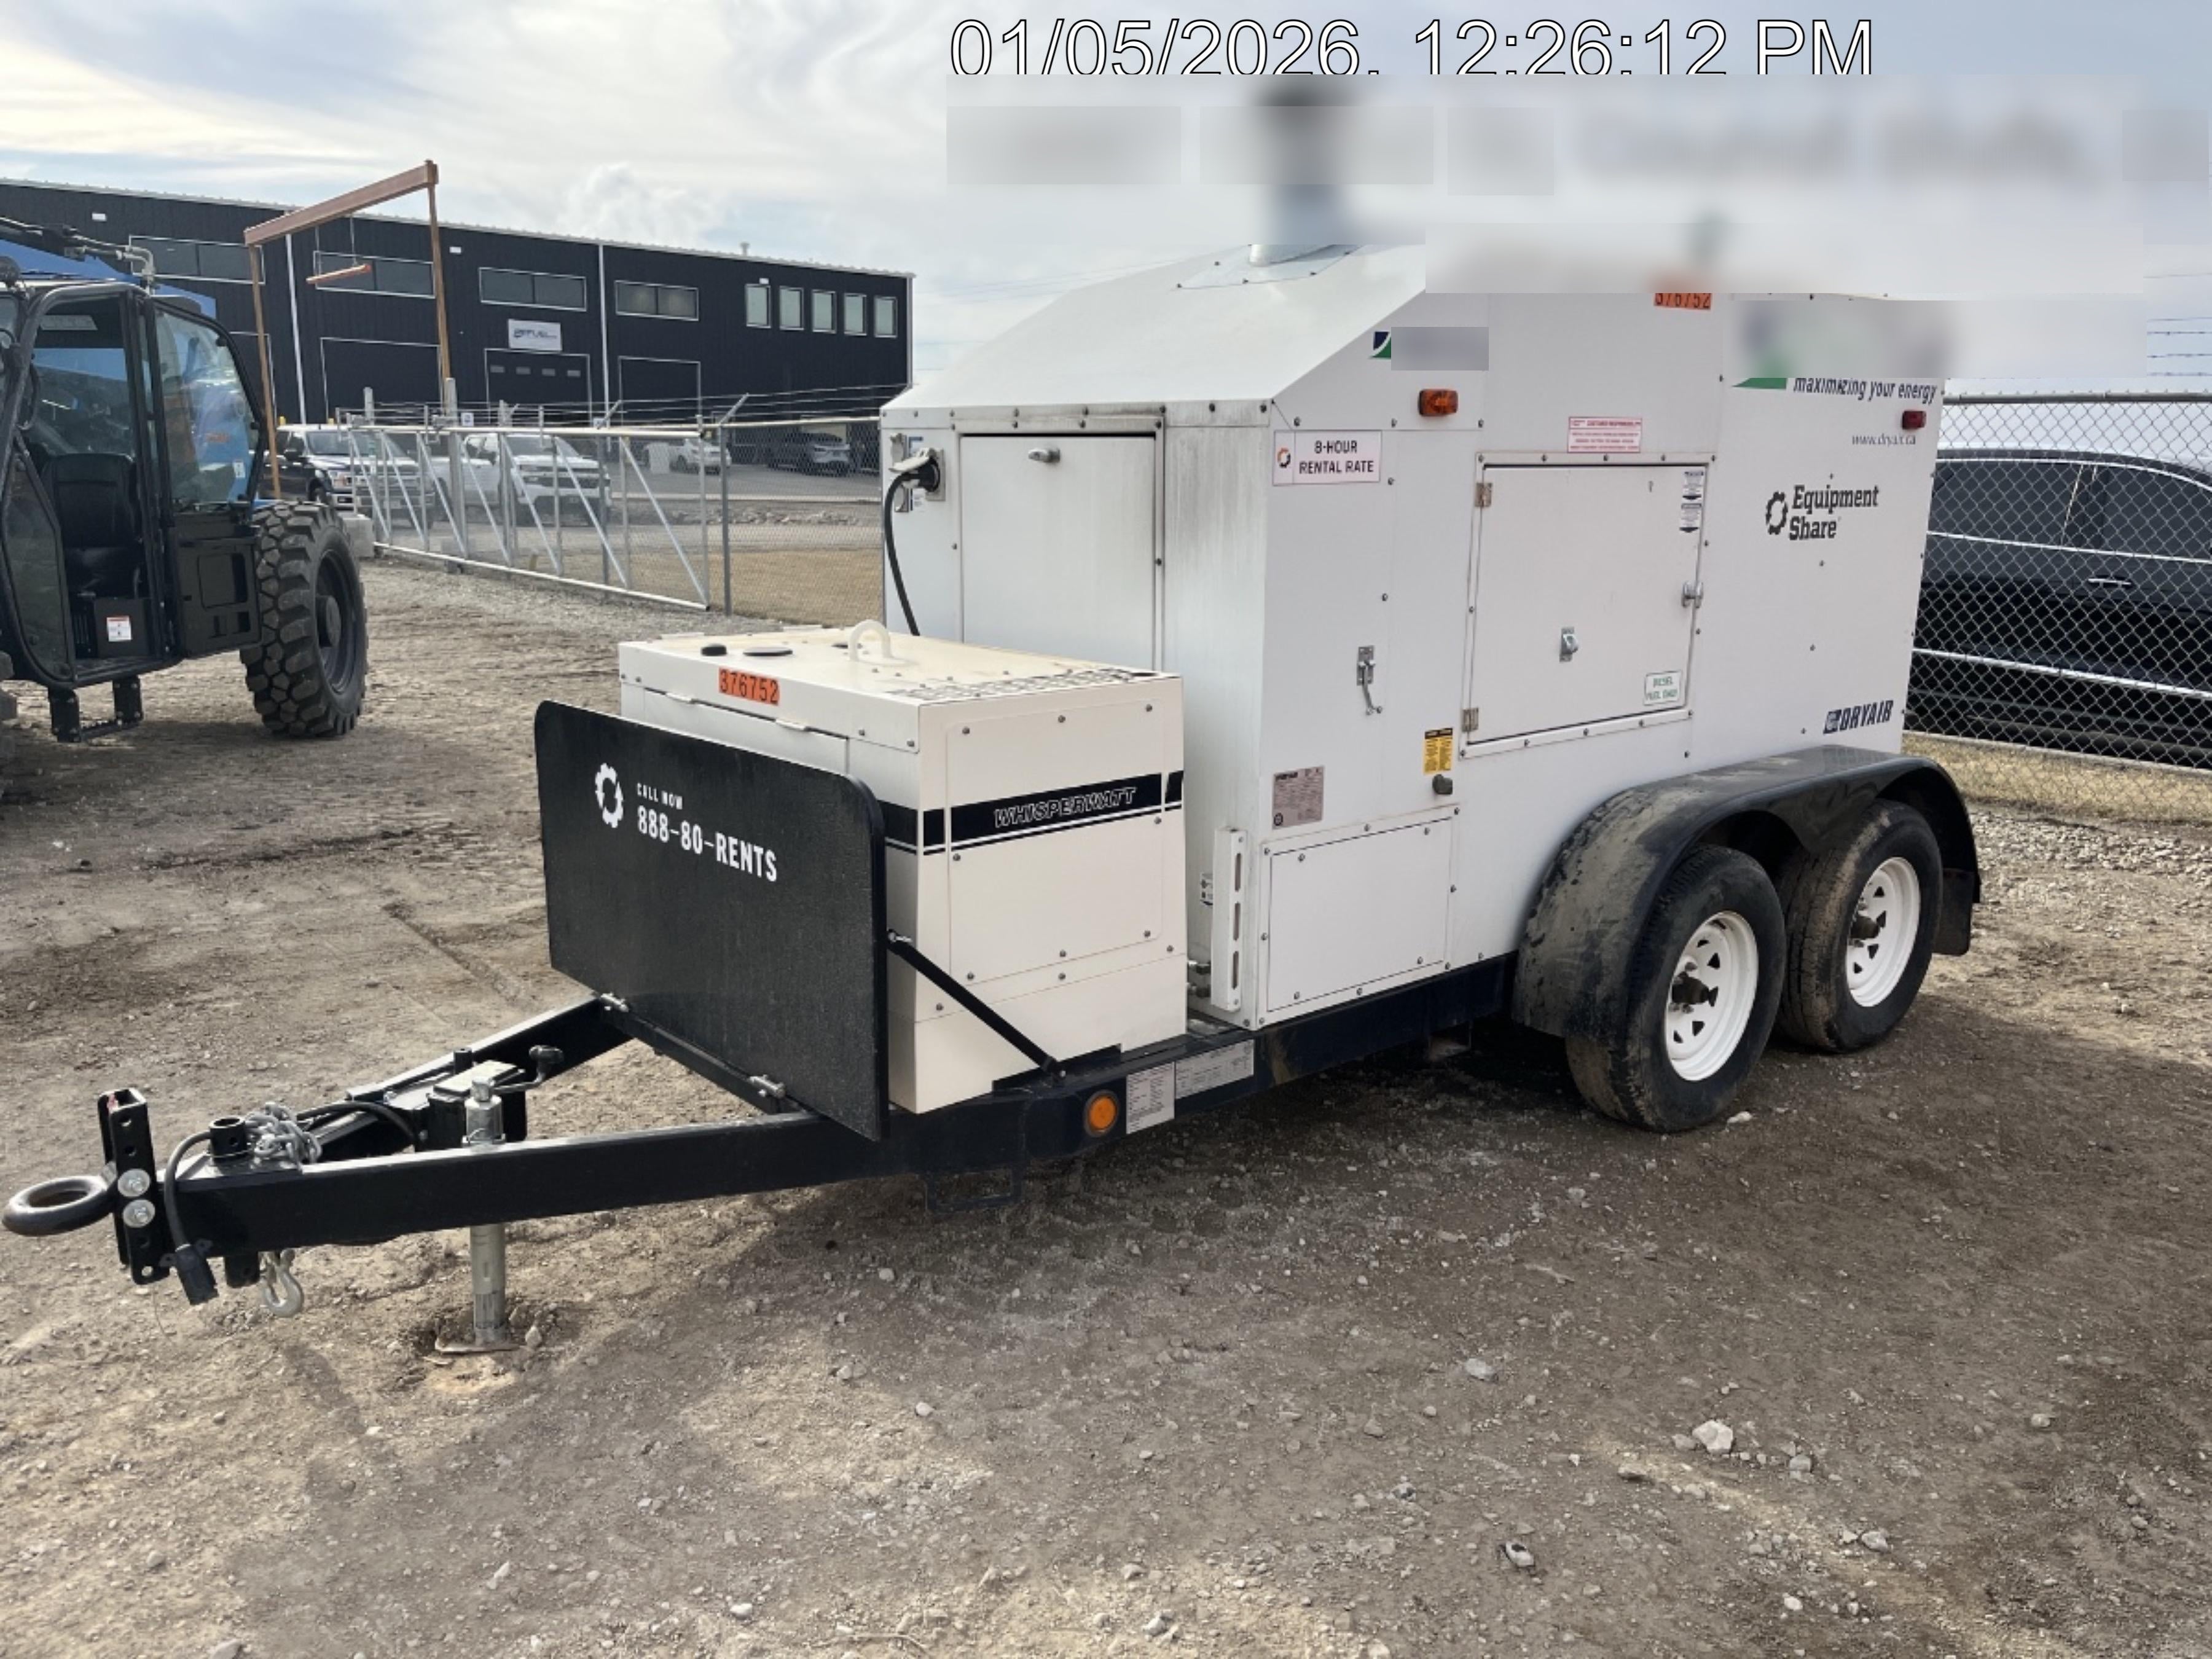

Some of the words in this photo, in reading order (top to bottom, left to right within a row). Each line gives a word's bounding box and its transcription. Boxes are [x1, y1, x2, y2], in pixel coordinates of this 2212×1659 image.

[1793, 378, 1867, 401] maximizing
[1869, 380, 1896, 402] your
[1897, 384, 1937, 404] energy
[1314, 440, 1358, 454] 8-HOUR
[1299, 461, 1343, 474] RENTAL
[1345, 460, 1375, 473] RATE
[1792, 484, 1879, 514] Equipment
[1789, 516, 1837, 541] Share
[720, 669, 779, 704] 376752
[1839, 700, 1894, 731] DRYAIR
[637, 782, 659, 802] CALL
[662, 790, 683, 810] NOW
[994, 786, 1137, 828] WHISPERWATT
[637, 805, 777, 882] 888-80-RENTS
